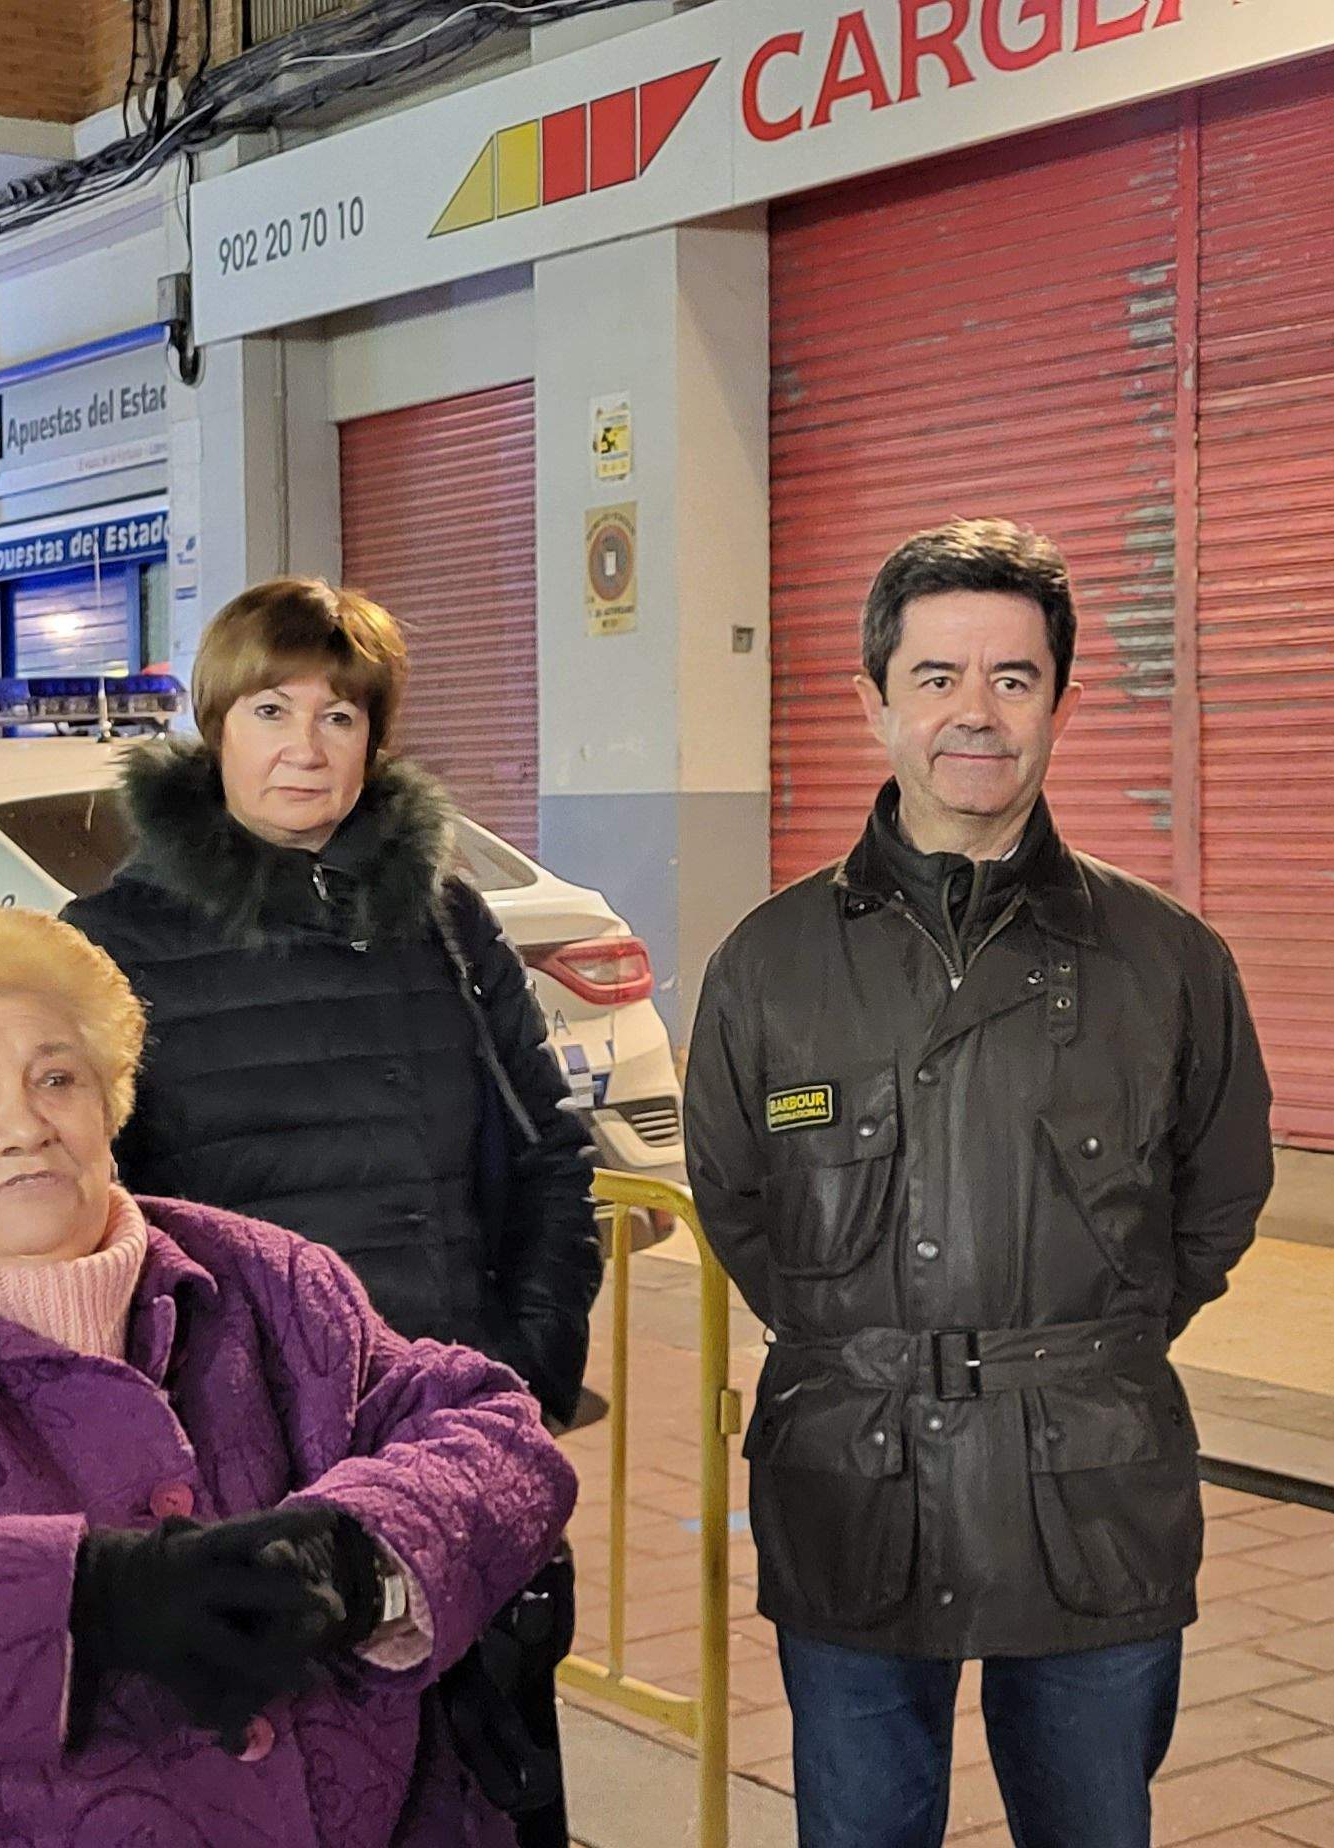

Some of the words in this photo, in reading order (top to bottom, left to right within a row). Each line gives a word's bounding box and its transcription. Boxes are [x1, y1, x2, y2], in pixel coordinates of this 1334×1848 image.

[219, 229, 258, 276] 902
[265, 219, 292, 262] 20
[300, 207, 327, 252] 70
[338, 196, 364, 240] 10
[7, 406, 81, 455] Apuestas
[88, 389, 114, 428] del
[70, 528, 99, 556] del
[770, 1091, 825, 1115] BARBOUR
